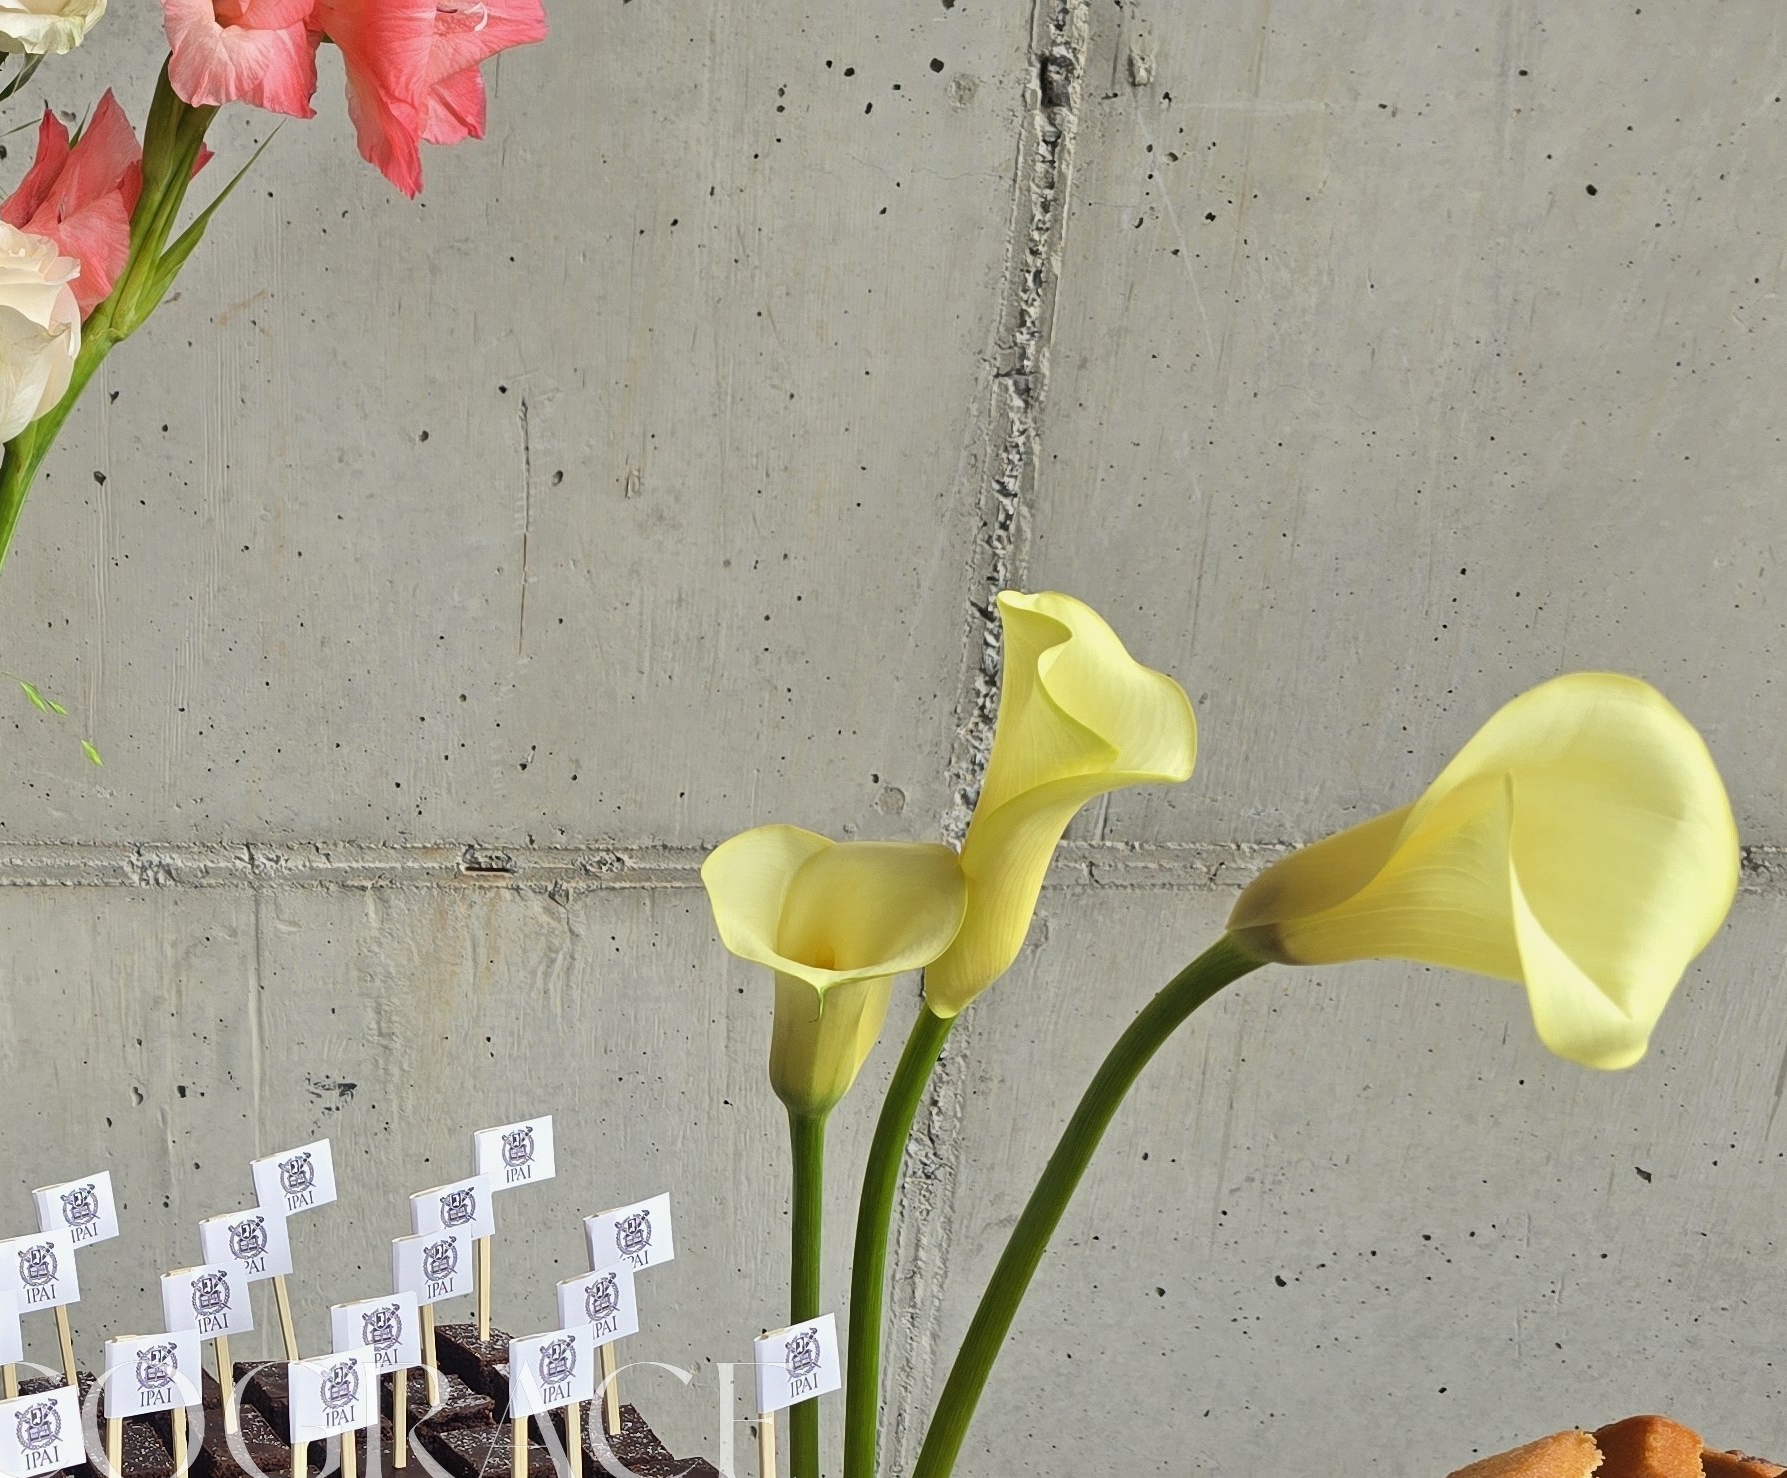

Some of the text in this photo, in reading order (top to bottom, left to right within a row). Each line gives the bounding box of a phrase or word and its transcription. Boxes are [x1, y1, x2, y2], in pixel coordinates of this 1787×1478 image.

[506, 1164, 531, 1183] IPAI
[288, 1191, 313, 1210] IPAI
[71, 1223, 97, 1242] IPAI
[26, 1285, 55, 1304] IPAI
[427, 1278, 453, 1299] IPAI
[198, 1313, 228, 1334] IPAI
[375, 1349, 398, 1367] PAI
[543, 1382, 570, 1404] IPAI
[790, 1373, 817, 1397] IPAI
[140, 1388, 171, 1407] IPAI
[326, 1406, 354, 1427] IPAI
[26, 1446, 59, 1470] IPAI
